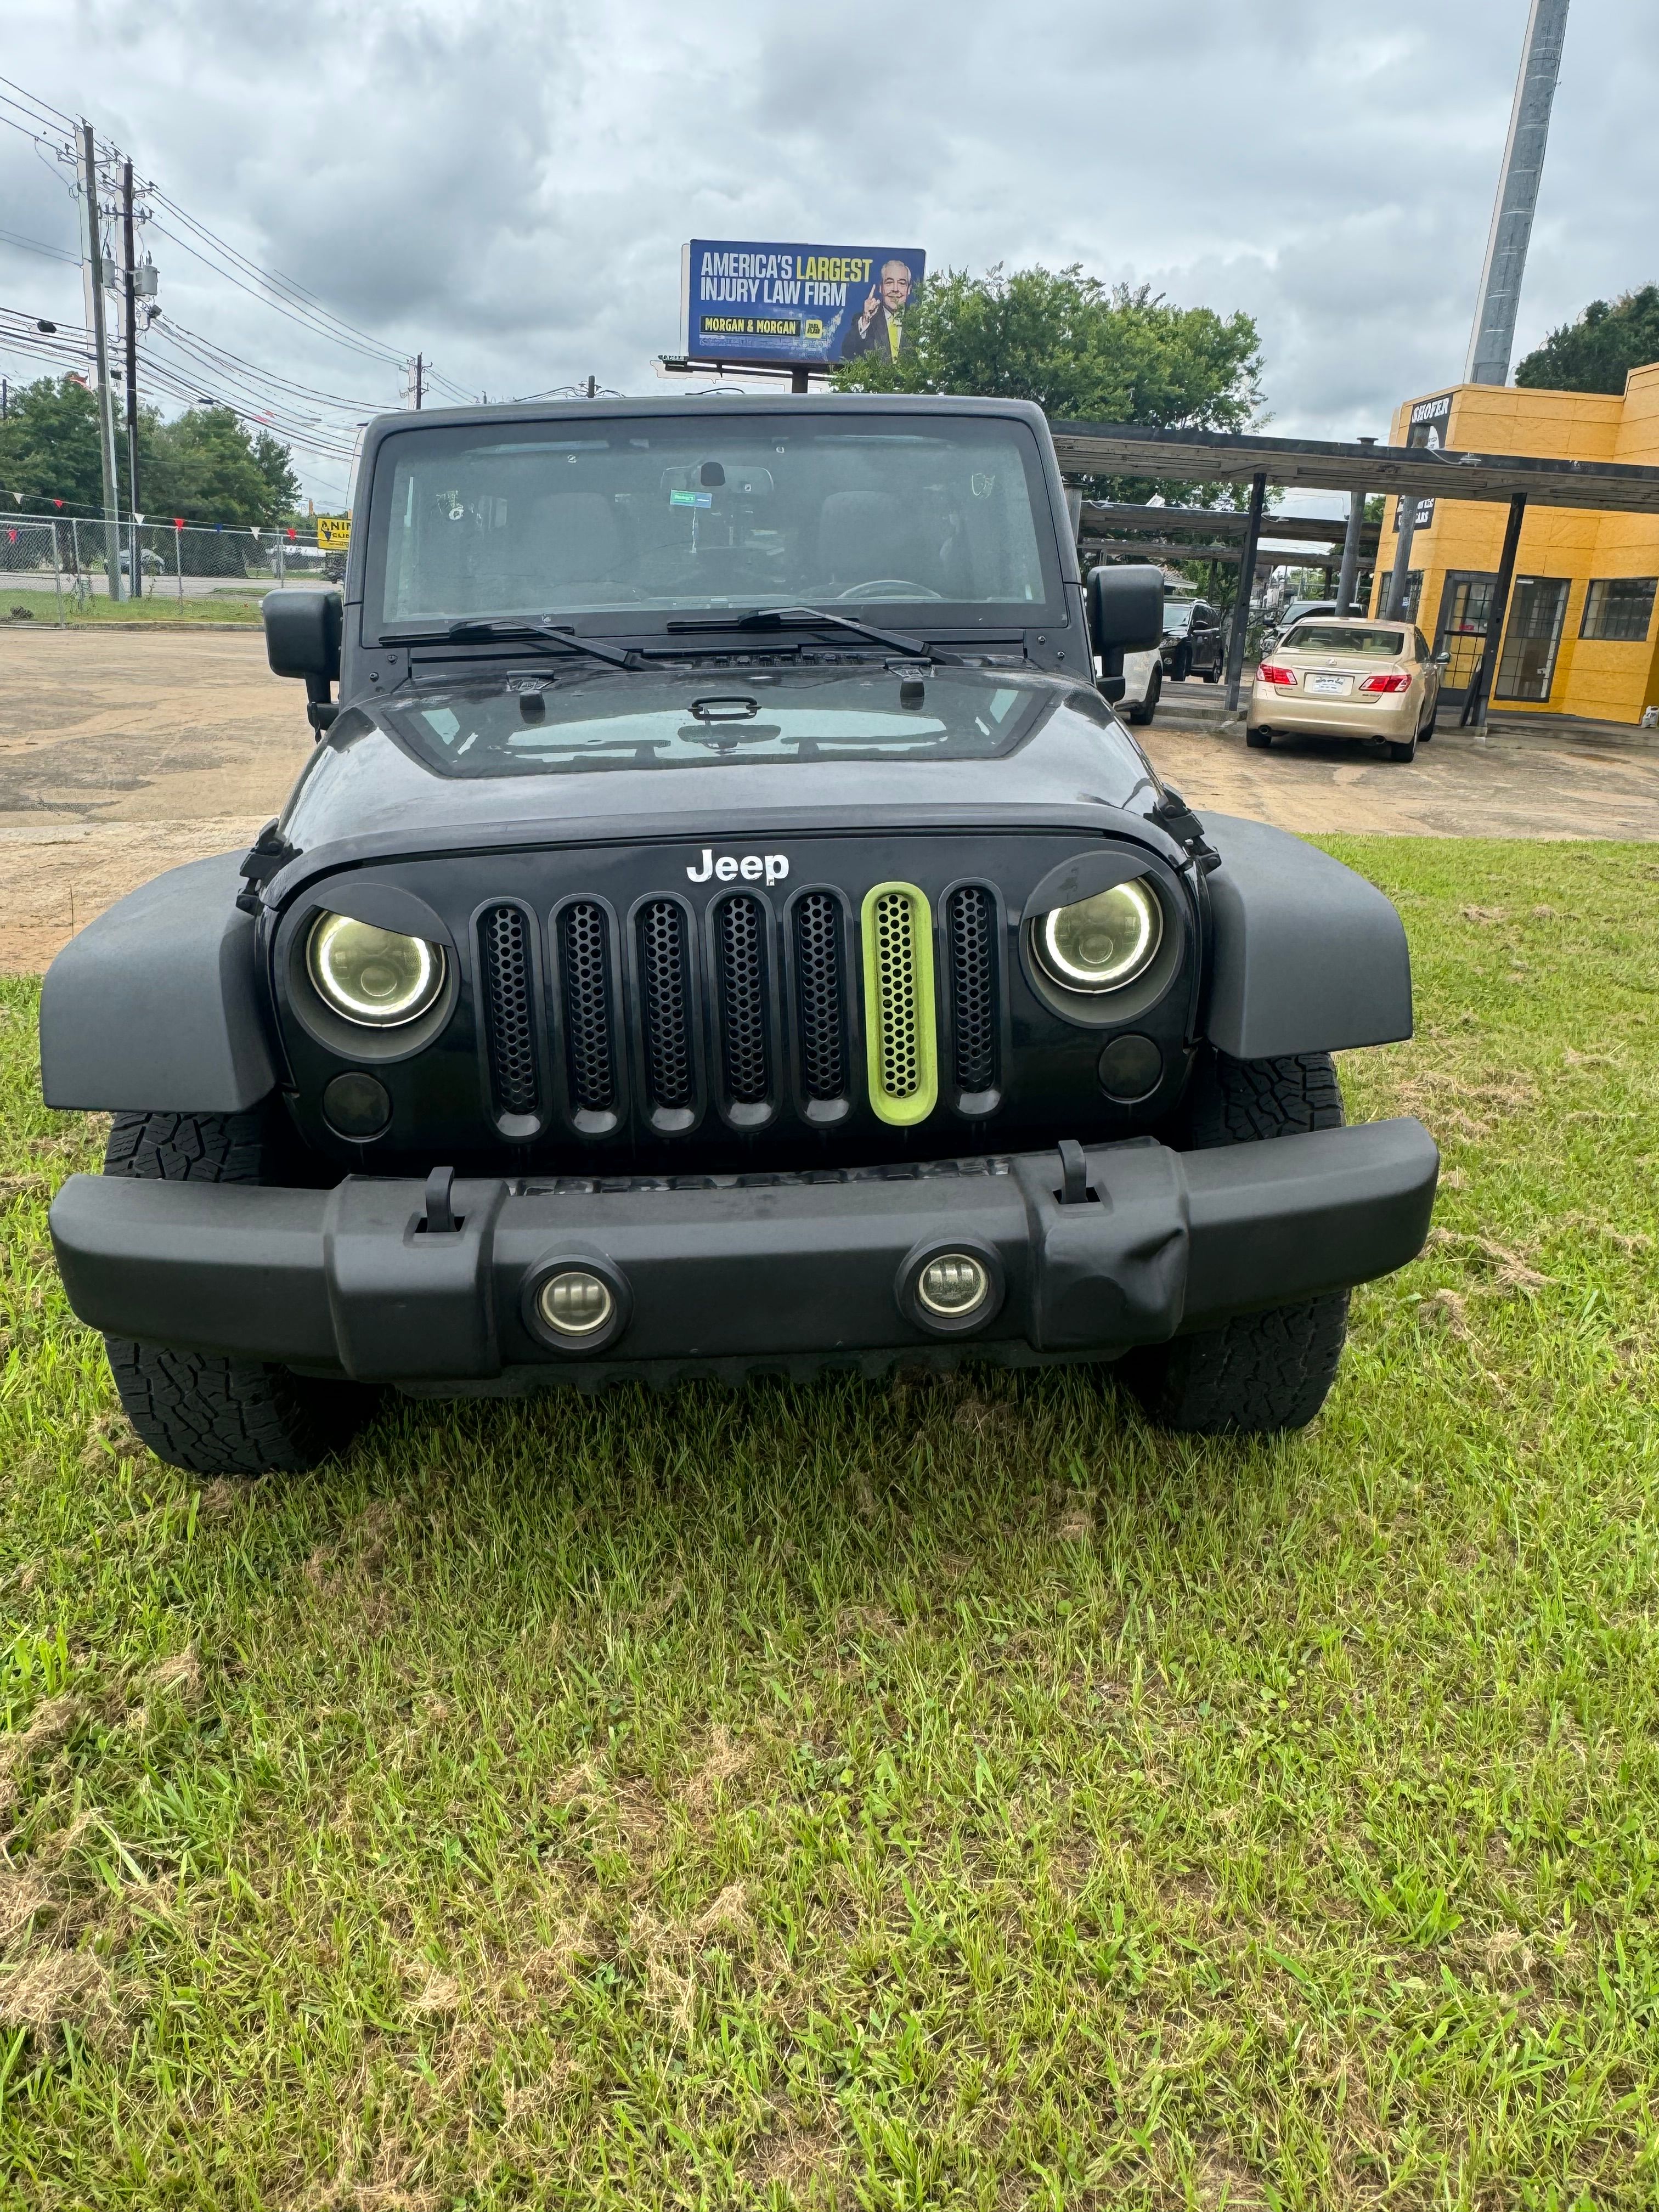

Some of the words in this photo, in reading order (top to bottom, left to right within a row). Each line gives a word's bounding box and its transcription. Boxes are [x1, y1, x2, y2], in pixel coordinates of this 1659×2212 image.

[701, 252, 793, 279] AMERICA'S
[797, 256, 873, 282] LARGEST
[701, 277, 760, 302] INJURY
[764, 279, 800, 304] LAW
[804, 281, 847, 307] FIRM
[705, 317, 744, 332] MORGAN
[747, 319, 754, 332] &
[757, 320, 796, 335] MORGAN
[686, 849, 789, 886] Jeep
